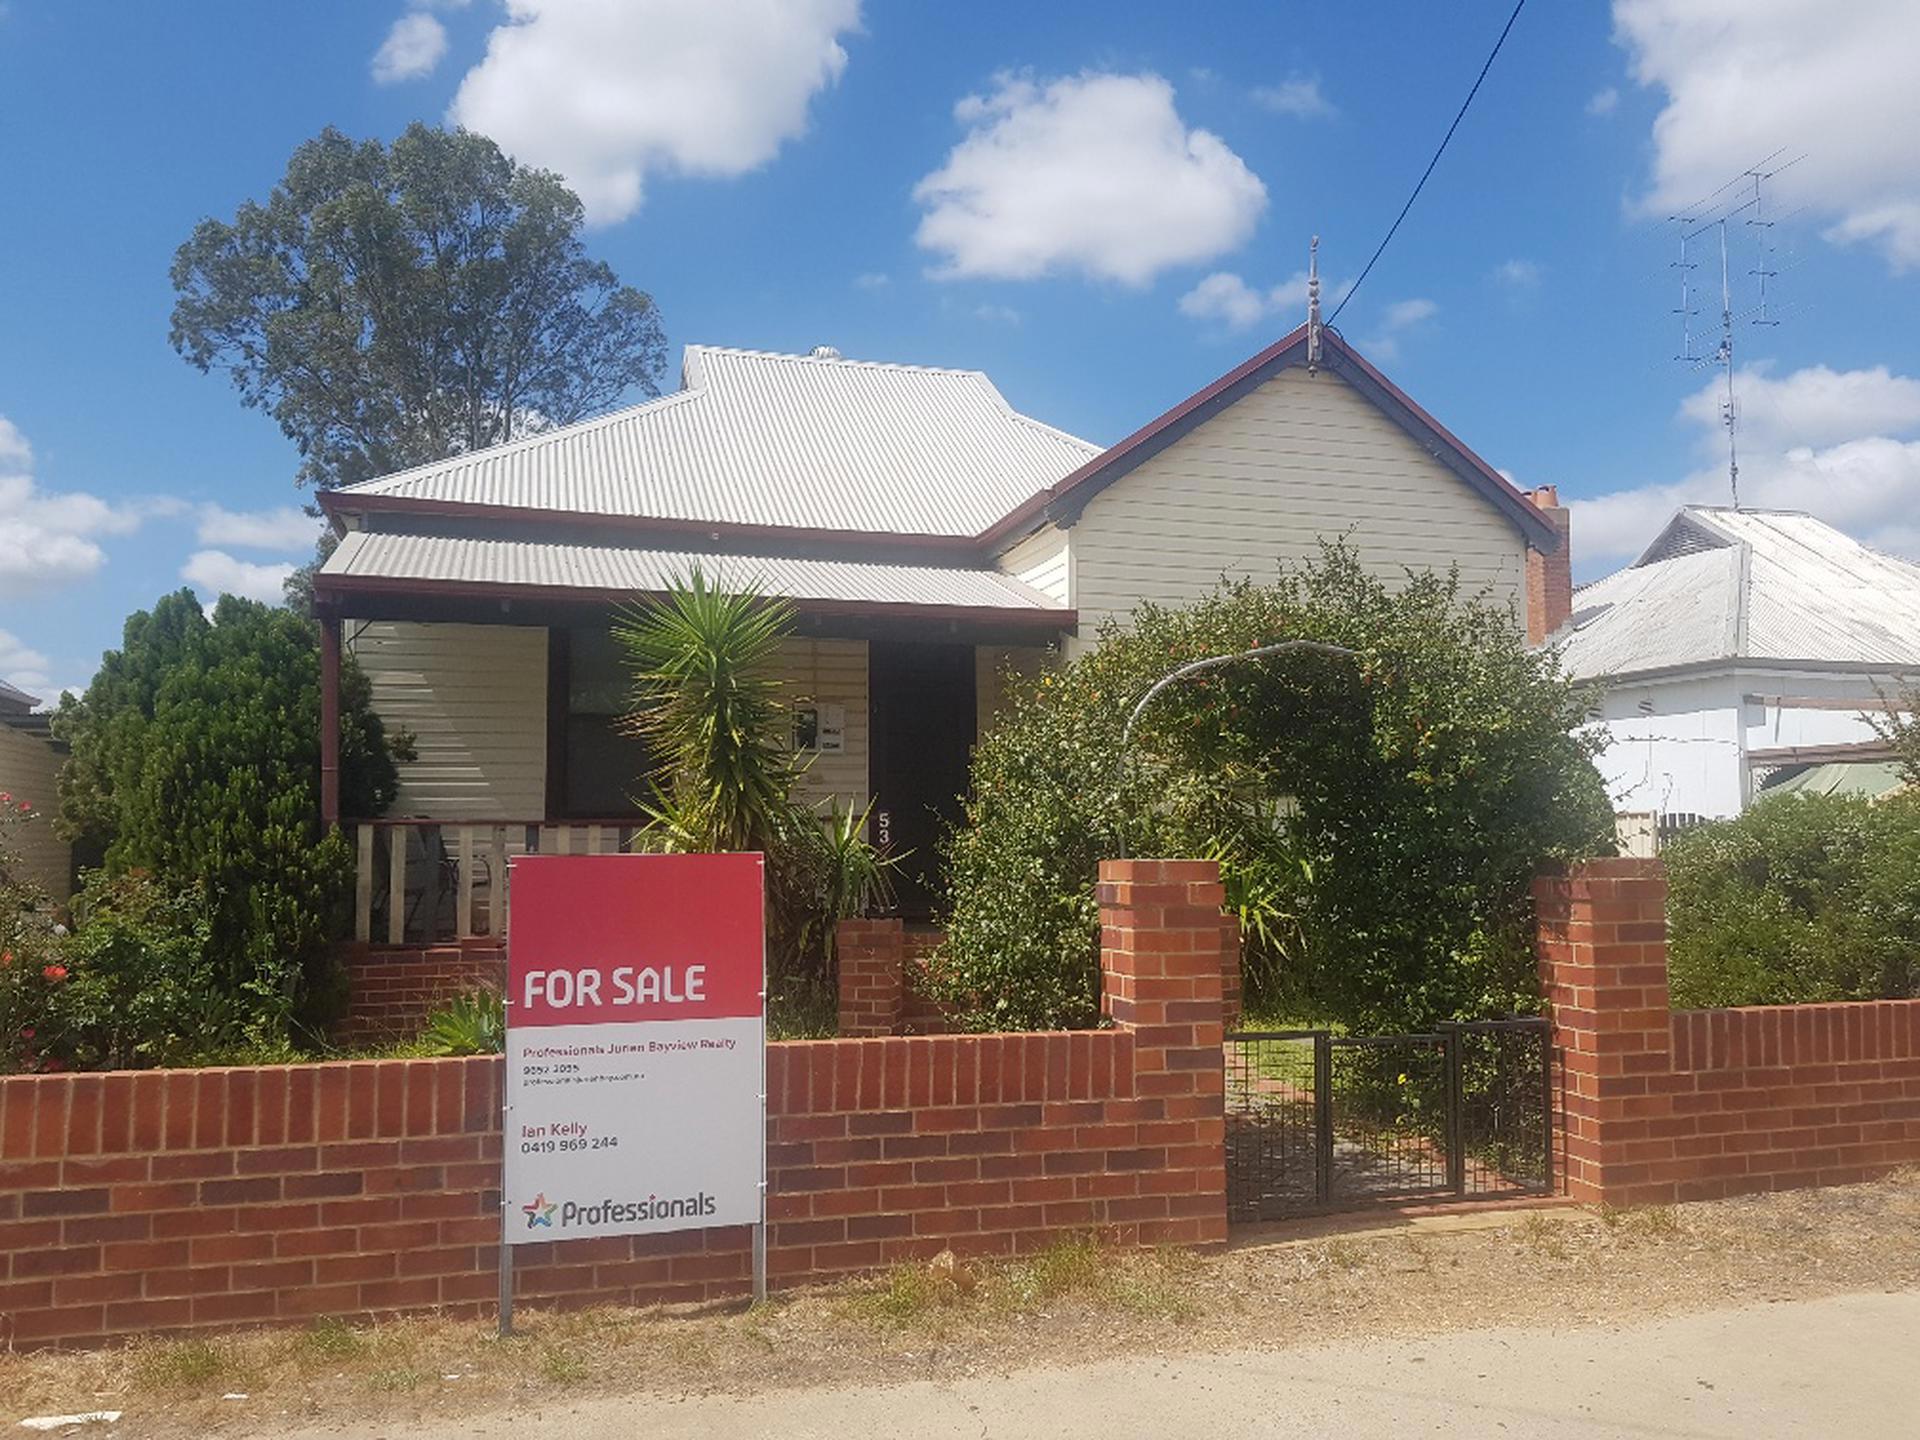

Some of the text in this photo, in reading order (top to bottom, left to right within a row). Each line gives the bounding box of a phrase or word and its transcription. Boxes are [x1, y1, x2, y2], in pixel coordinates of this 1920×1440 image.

[524, 965, 706, 1009] FOR SALE
[523, 1044, 604, 1058] Professionals
[649, 1040, 698, 1054] Bayview
[701, 1039, 737, 1051] Realty
[521, 1121, 588, 1138] Ian Kelly
[521, 1136, 618, 1154] 0419 969 244
[562, 1191, 716, 1228] Professionals
